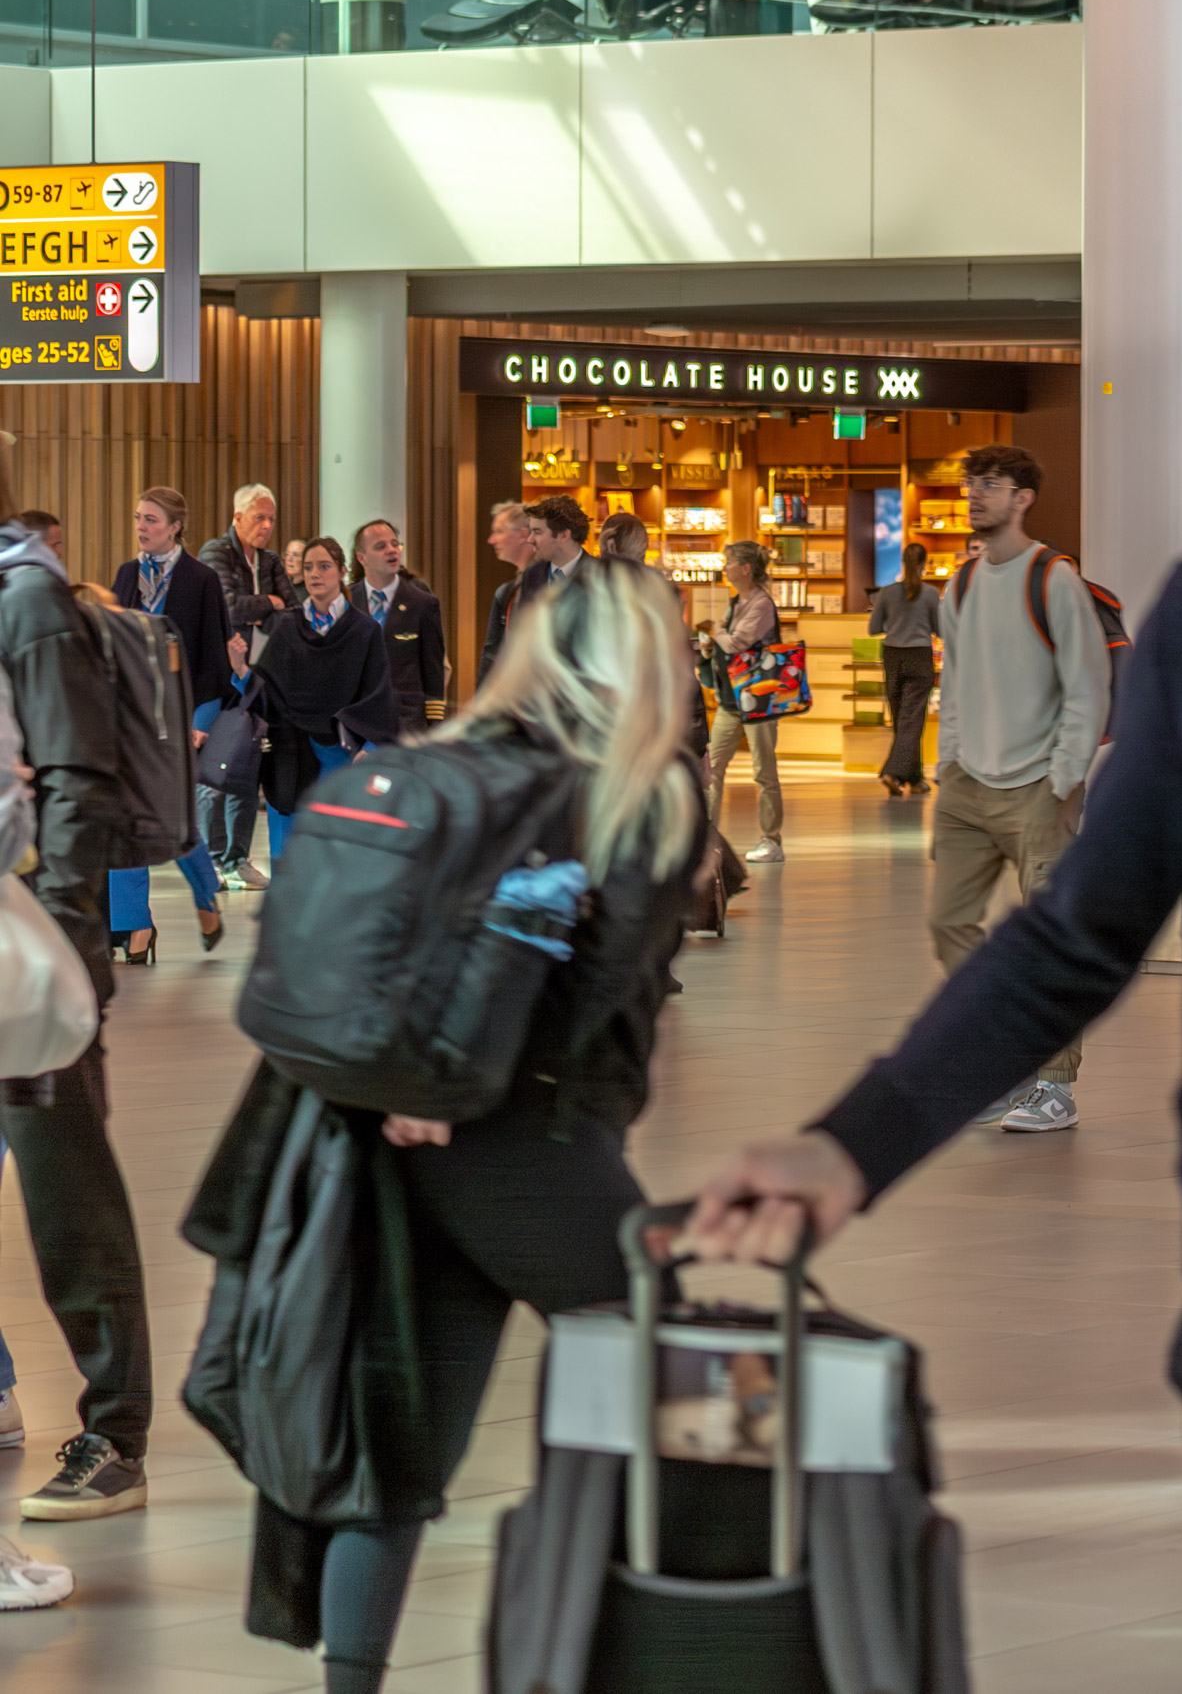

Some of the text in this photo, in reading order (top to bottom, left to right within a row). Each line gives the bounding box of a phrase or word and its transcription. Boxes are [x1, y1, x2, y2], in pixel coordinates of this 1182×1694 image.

[13, 184, 63, 204] 59-87
[11, 278, 88, 303] First aid
[21, 304, 89, 324] Eerste hulp
[37, 341, 90, 363] 25-52
[504, 354, 725, 390] CHOCOLATE
[747, 364, 859, 395] HOUSE
